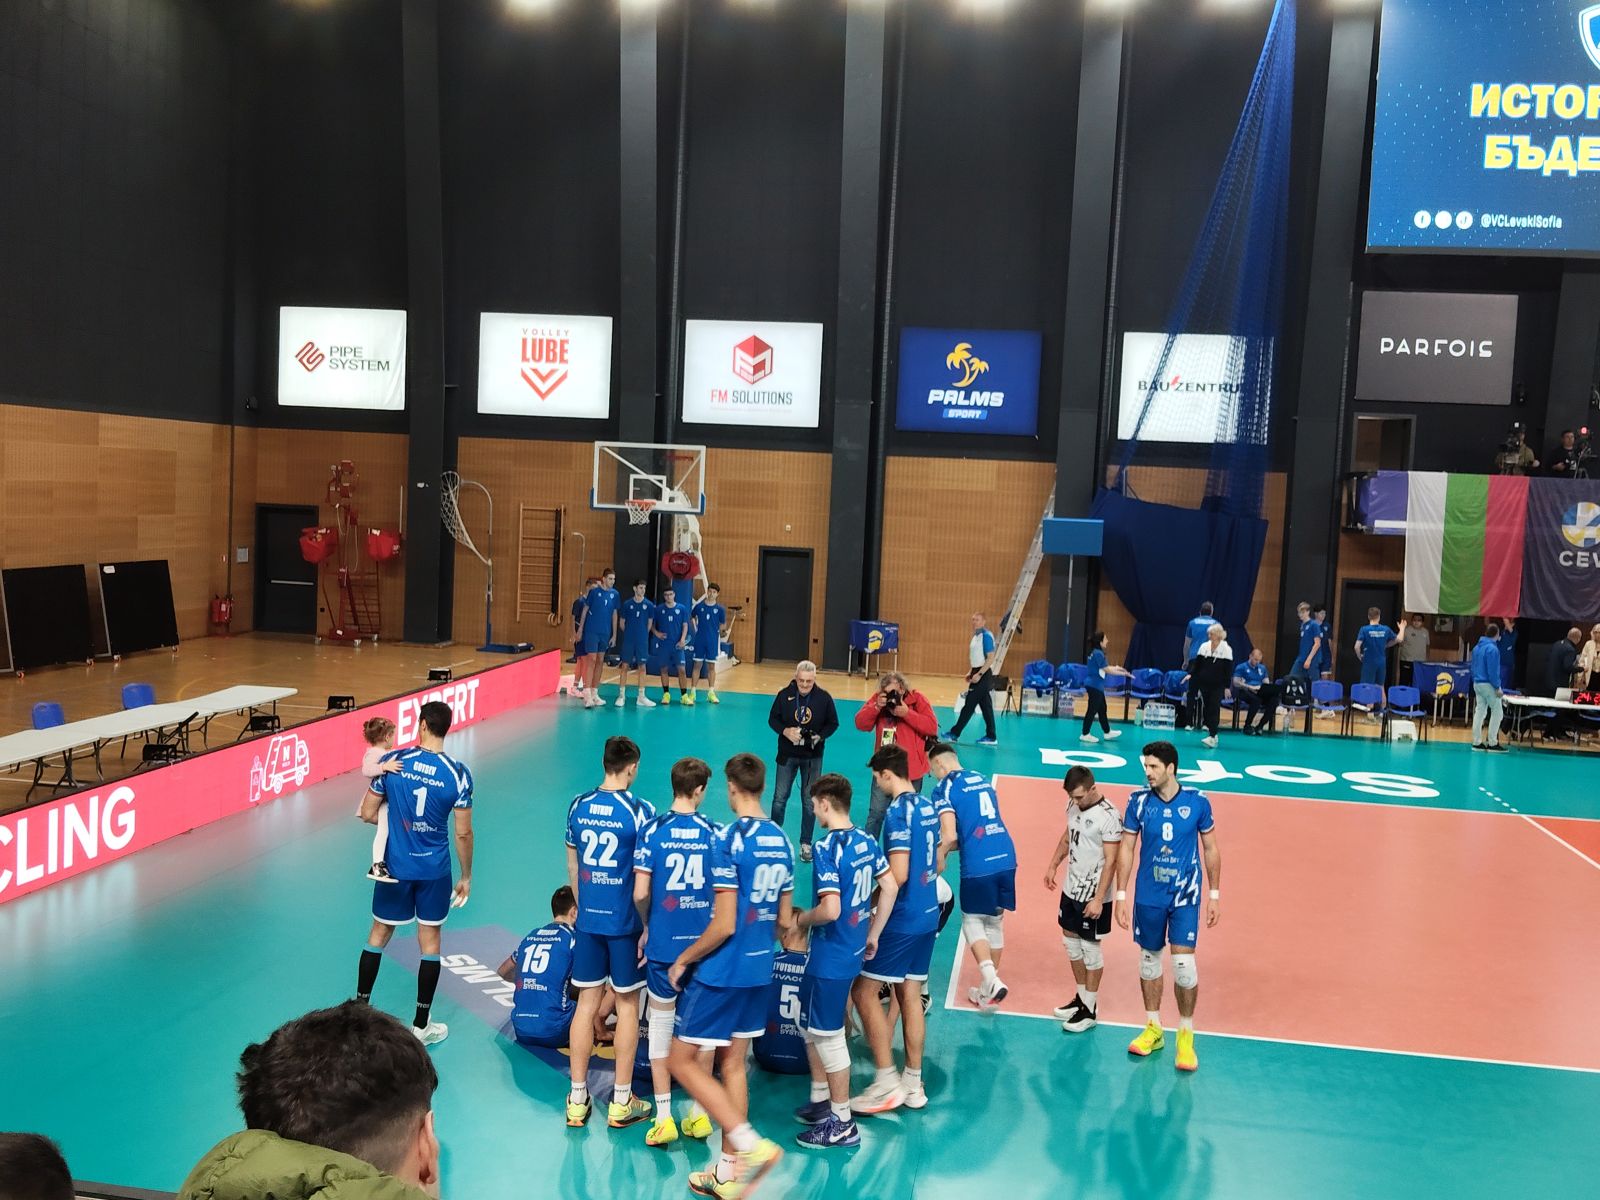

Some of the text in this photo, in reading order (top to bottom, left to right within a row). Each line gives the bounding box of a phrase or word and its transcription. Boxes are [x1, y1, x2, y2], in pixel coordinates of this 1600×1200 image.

[1484, 135, 1600, 177] БЪДЕ
[522, 328, 570, 337] VOLLEY
[329, 345, 363, 358] PIPE
[521, 337, 569, 365] LUBE
[1380, 337, 1493, 358] PARFOIS
[329, 358, 390, 372] SYSTEM
[1138, 380, 1240, 394] BAUZENTRU
[711, 389, 793, 405] FM SOLUTIONS
[928, 389, 1004, 407] PALMS
[948, 408, 982, 419] SPORT
[398, 678, 480, 746] EXERT
[400, 771, 445, 788] VIVACOM
[413, 786, 428, 817] 1
[979, 791, 996, 819] 4
[577, 817, 624, 829] VIVACOM
[1162, 822, 1174, 841] 8
[660, 842, 710, 850] VIVACOM
[1070, 829, 1080, 847] 14
[581, 829, 619, 868] 22
[592, 871, 609, 880] PIPE
[665, 853, 706, 891] 24
[750, 863, 789, 904] 99
[851, 865, 873, 907] 20
[680, 901, 709, 909] SYSTEM
[522, 944, 552, 974] 15
[773, 961, 805, 975] YUTSKAN
[771, 972, 803, 982] IVAC
[523, 983, 548, 991] SYSTEM
[780, 984, 800, 1019] 5
